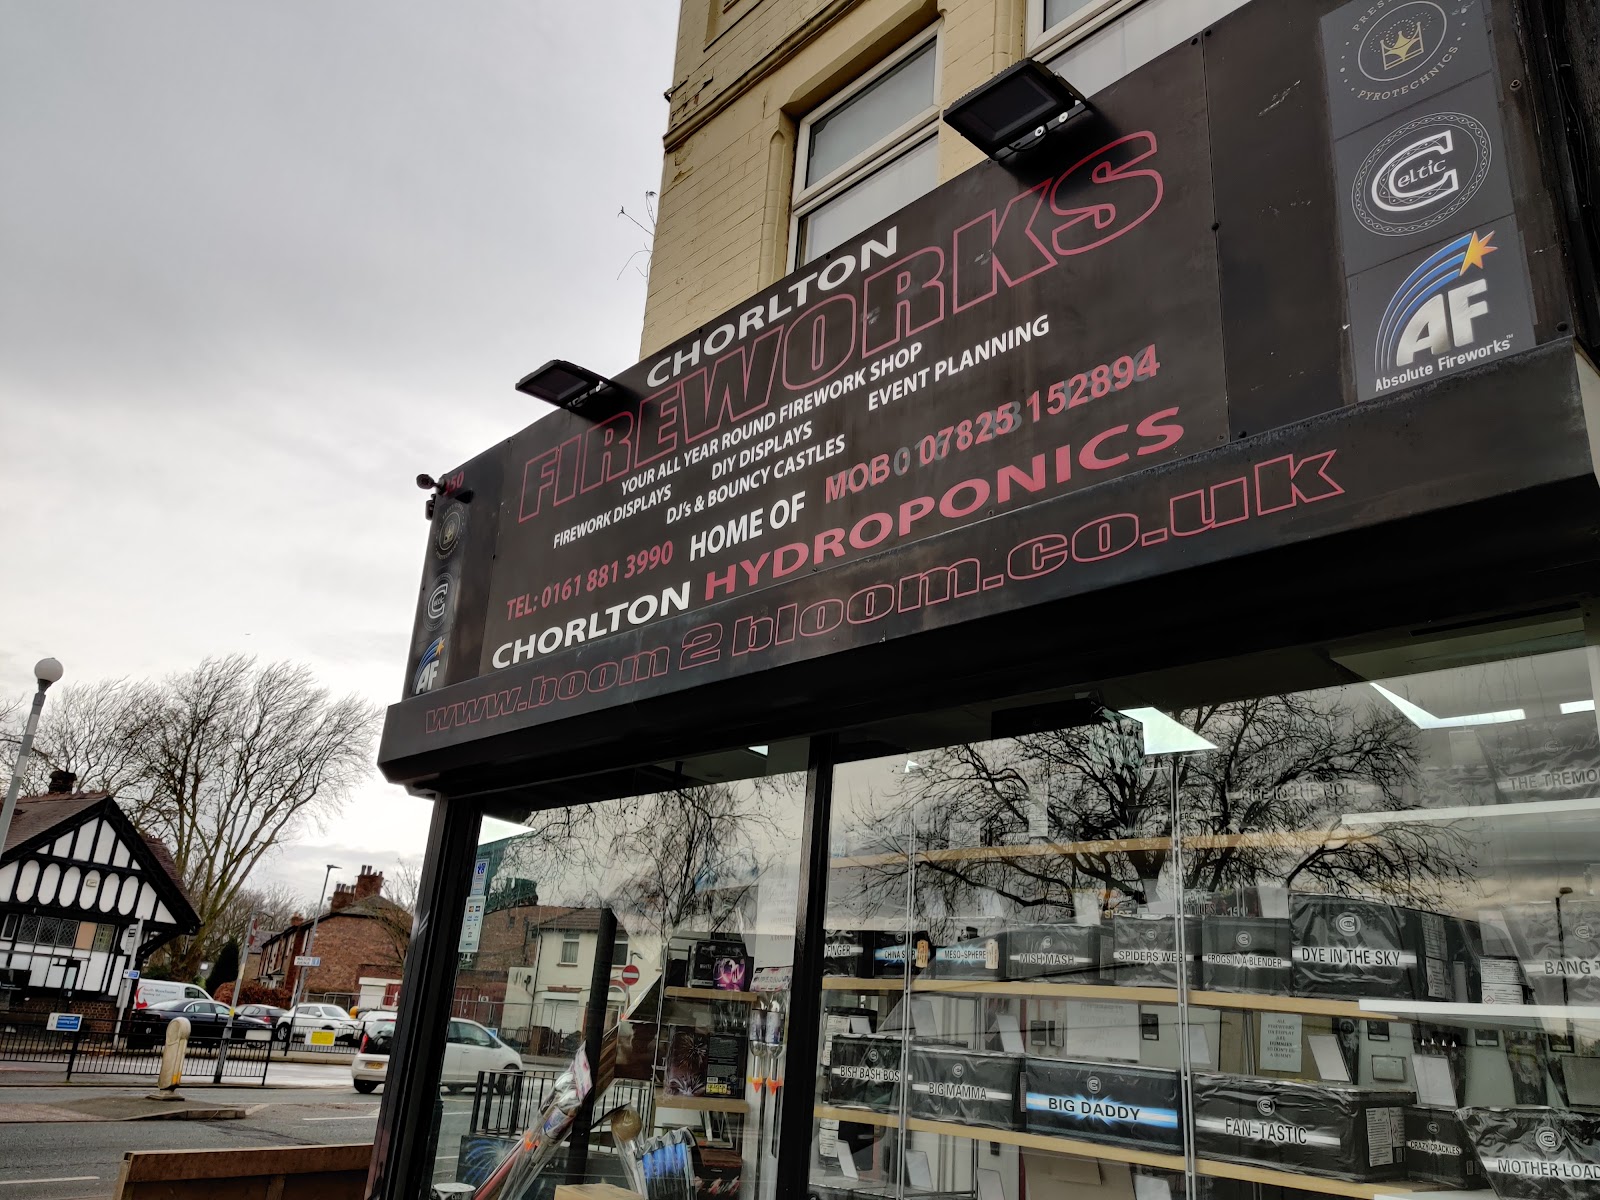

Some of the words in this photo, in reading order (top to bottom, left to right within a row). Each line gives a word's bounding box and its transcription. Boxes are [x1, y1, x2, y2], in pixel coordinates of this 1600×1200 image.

[1357, 46, 1459, 101] PYROTECHNICS
[646, 226, 898, 388] CHORLTON
[1396, 278, 1489, 367] AF
[517, 130, 1164, 524] FIREWORKS
[868, 367, 931, 411] EVENT
[935, 314, 1050, 382] PLANNING
[1375, 365, 1434, 393] Absolute
[622, 470, 656, 496] YOUR
[656, 456, 681, 480] ALL
[683, 439, 719, 468] YEAR
[721, 411, 776, 451] ROUND
[779, 367, 866, 424] FIREWORK
[870, 341, 923, 381] SHOP
[919, 402, 1015, 466] 07825
[1026, 344, 1160, 423] 152894
[711, 454, 737, 480] DIY
[739, 420, 813, 464] DISPLAYS
[666, 501, 692, 524] DJ's
[694, 495, 705, 513] &
[707, 463, 771, 508] BOUNCY
[773, 434, 846, 479] CASTLES
[553, 511, 611, 549] FIREWORK
[613, 484, 672, 523] DISPLAYS
[690, 508, 763, 562] HOME
[769, 491, 806, 531] OF
[492, 580, 691, 669] CHORLTON
[704, 406, 1185, 601] HYDROPONICS
[425, 646, 670, 734] www.boom
[678, 622, 723, 671] 2
[731, 449, 1346, 657] bloom.co.uk
[507, 592, 538, 621] TEL:
[541, 574, 582, 608] 0161
[586, 560, 619, 592] 881
[624, 540, 674, 579] 3990
[415, 660, 439, 695] AF
[1508, 775, 1538, 791] THE
[1541, 768, 1600, 787] TREMO
[884, 950, 900, 959] CHINA
[901, 950, 917, 959] SR
[944, 950, 987, 959] MESO-SPHERE
[1019, 953, 1043, 964] MISH
[1044, 954, 1075, 965] MASH
[1118, 950, 1159, 962] SPIDERS
[1207, 954, 1231, 965] FROGS
[1231, 955, 1240, 965] IN
[1241, 956, 1247, 966] A
[1249, 956, 1282, 968] BLENDER
[1302, 947, 1326, 962] DYE
[1330, 948, 1343, 963] IN
[1346, 949, 1370, 965] THE
[1375, 950, 1400, 966] SKY
[1544, 960, 1591, 975] BANG
[840, 1066, 858, 1077] BISH
[859, 1067, 881, 1080] BASH
[884, 1069, 905, 1082] BOS
[928, 1082, 944, 1095] BIG
[946, 1084, 987, 1100] MAMMA
[1047, 1096, 1075, 1113] BIG
[1081, 1098, 1141, 1121] DADDY
[1224, 1117, 1307, 1145] FAN-TASTIC
[1410, 1140, 1430, 1151] CRAZY
[1430, 1143, 1460, 1155] CRACKLES
